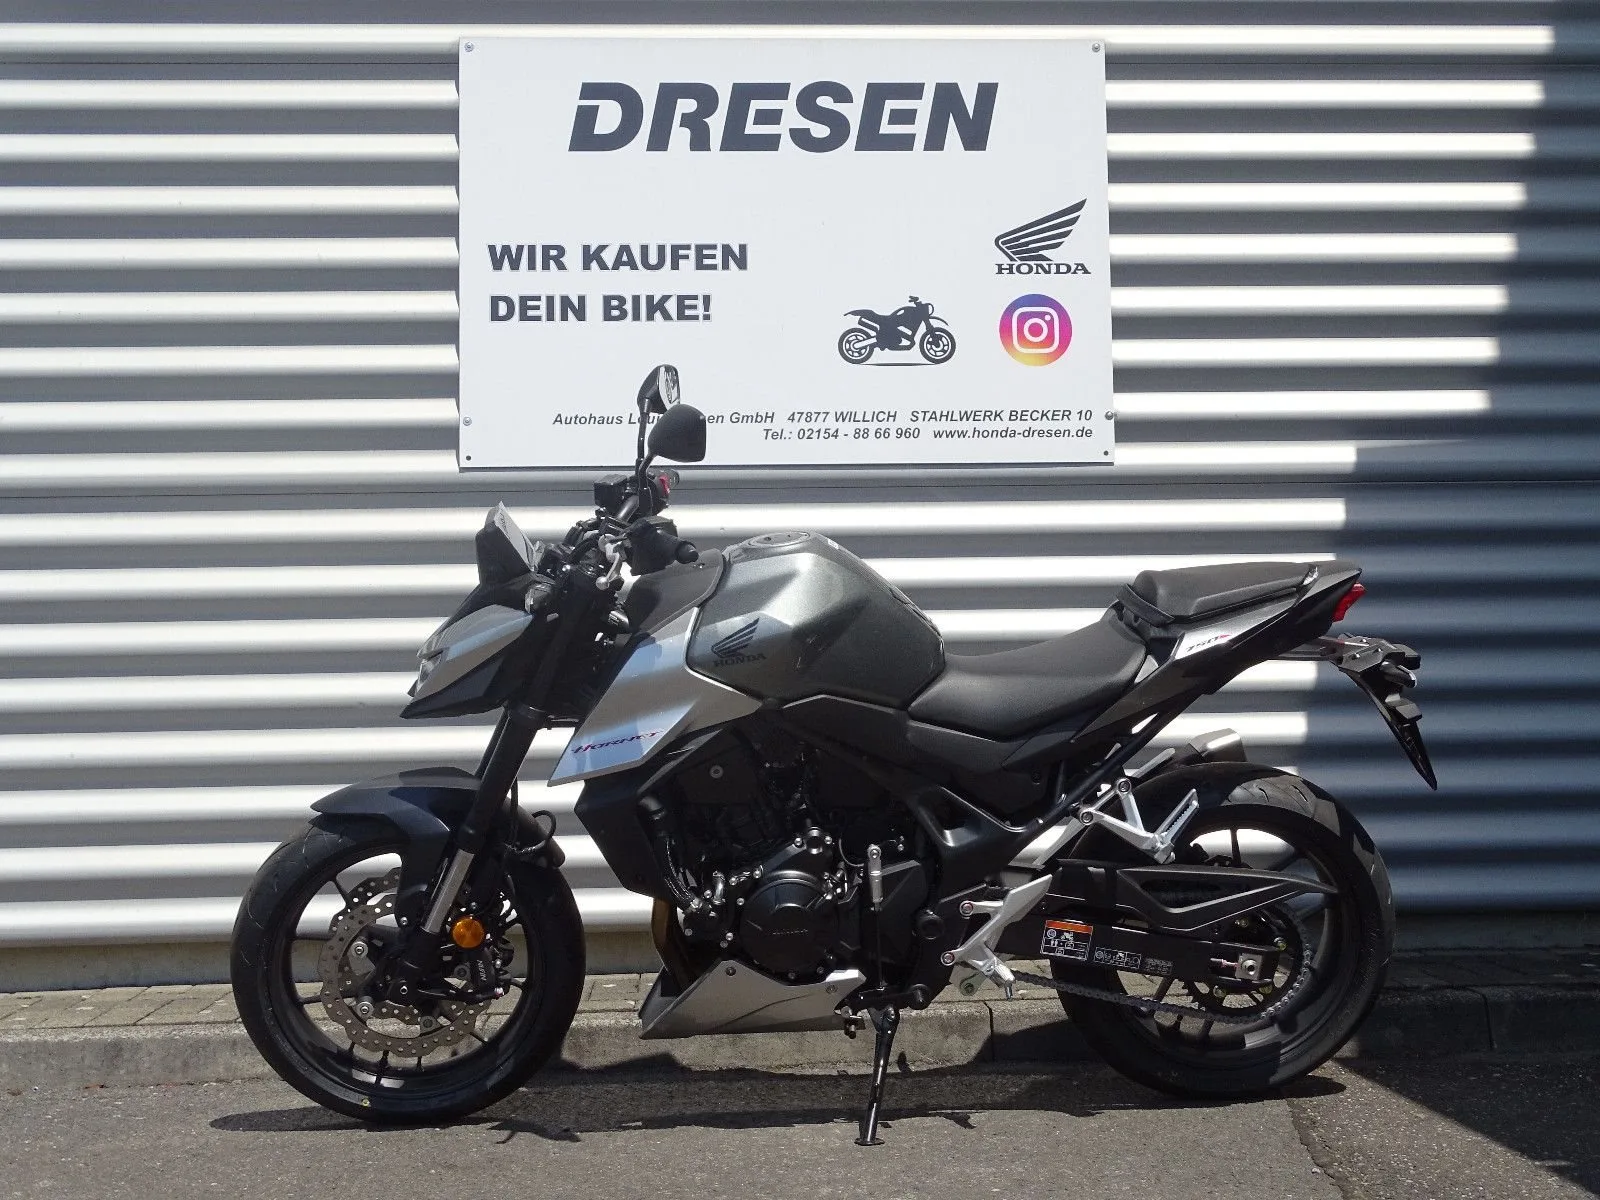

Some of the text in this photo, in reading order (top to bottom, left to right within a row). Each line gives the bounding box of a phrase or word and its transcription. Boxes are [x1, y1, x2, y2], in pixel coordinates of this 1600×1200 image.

[567, 80, 999, 154] DRESEN
[487, 242, 750, 272] WIR KAUFEN
[994, 262, 1092, 276] HONDA
[490, 293, 713, 323] DEIN BIKE!
[552, 412, 624, 426] Autohaus
[729, 411, 776, 425] GmbH
[786, 411, 831, 424] 47877
[834, 410, 898, 424] WILLICH
[909, 409, 1005, 423] STAHLWERK
[1008, 409, 1073, 422] BECKER
[1077, 409, 1093, 422] 10
[763, 428, 793, 441] Tel.:
[797, 427, 840, 440] 02154
[853, 427, 870, 440] 88
[874, 427, 891, 440] 66
[895, 427, 921, 440] 960
[932, 425, 1093, 440] www.honda-dresen.de
[712, 652, 767, 668] HONDA
